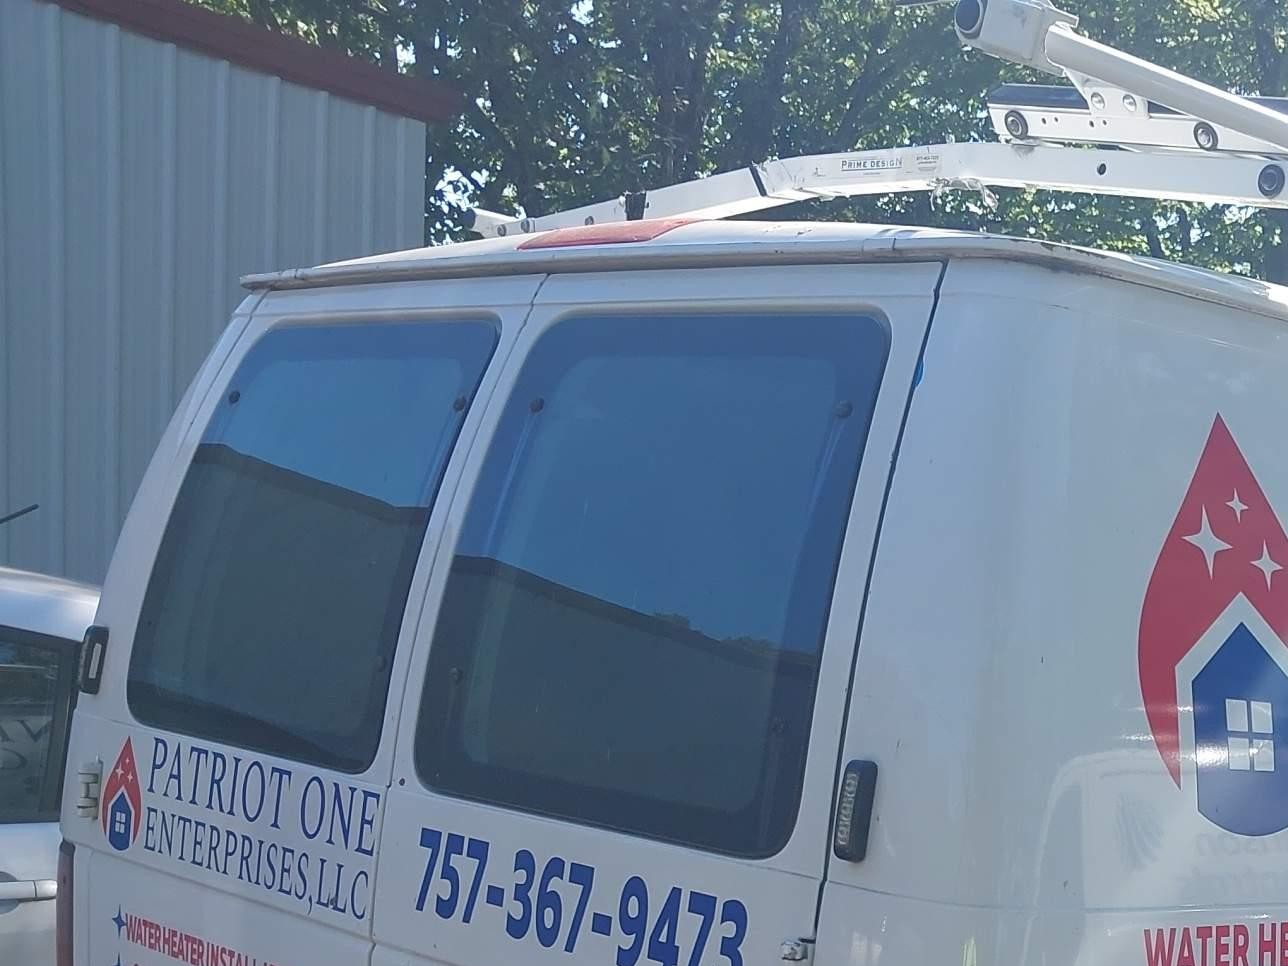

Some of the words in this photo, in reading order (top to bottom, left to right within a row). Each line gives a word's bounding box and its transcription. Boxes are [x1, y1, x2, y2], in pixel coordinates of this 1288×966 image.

[147, 737, 292, 829] PATRIOT
[300, 776, 381, 857] ONE
[125, 913, 161, 952] WATER
[162, 922, 205, 964] HEATER
